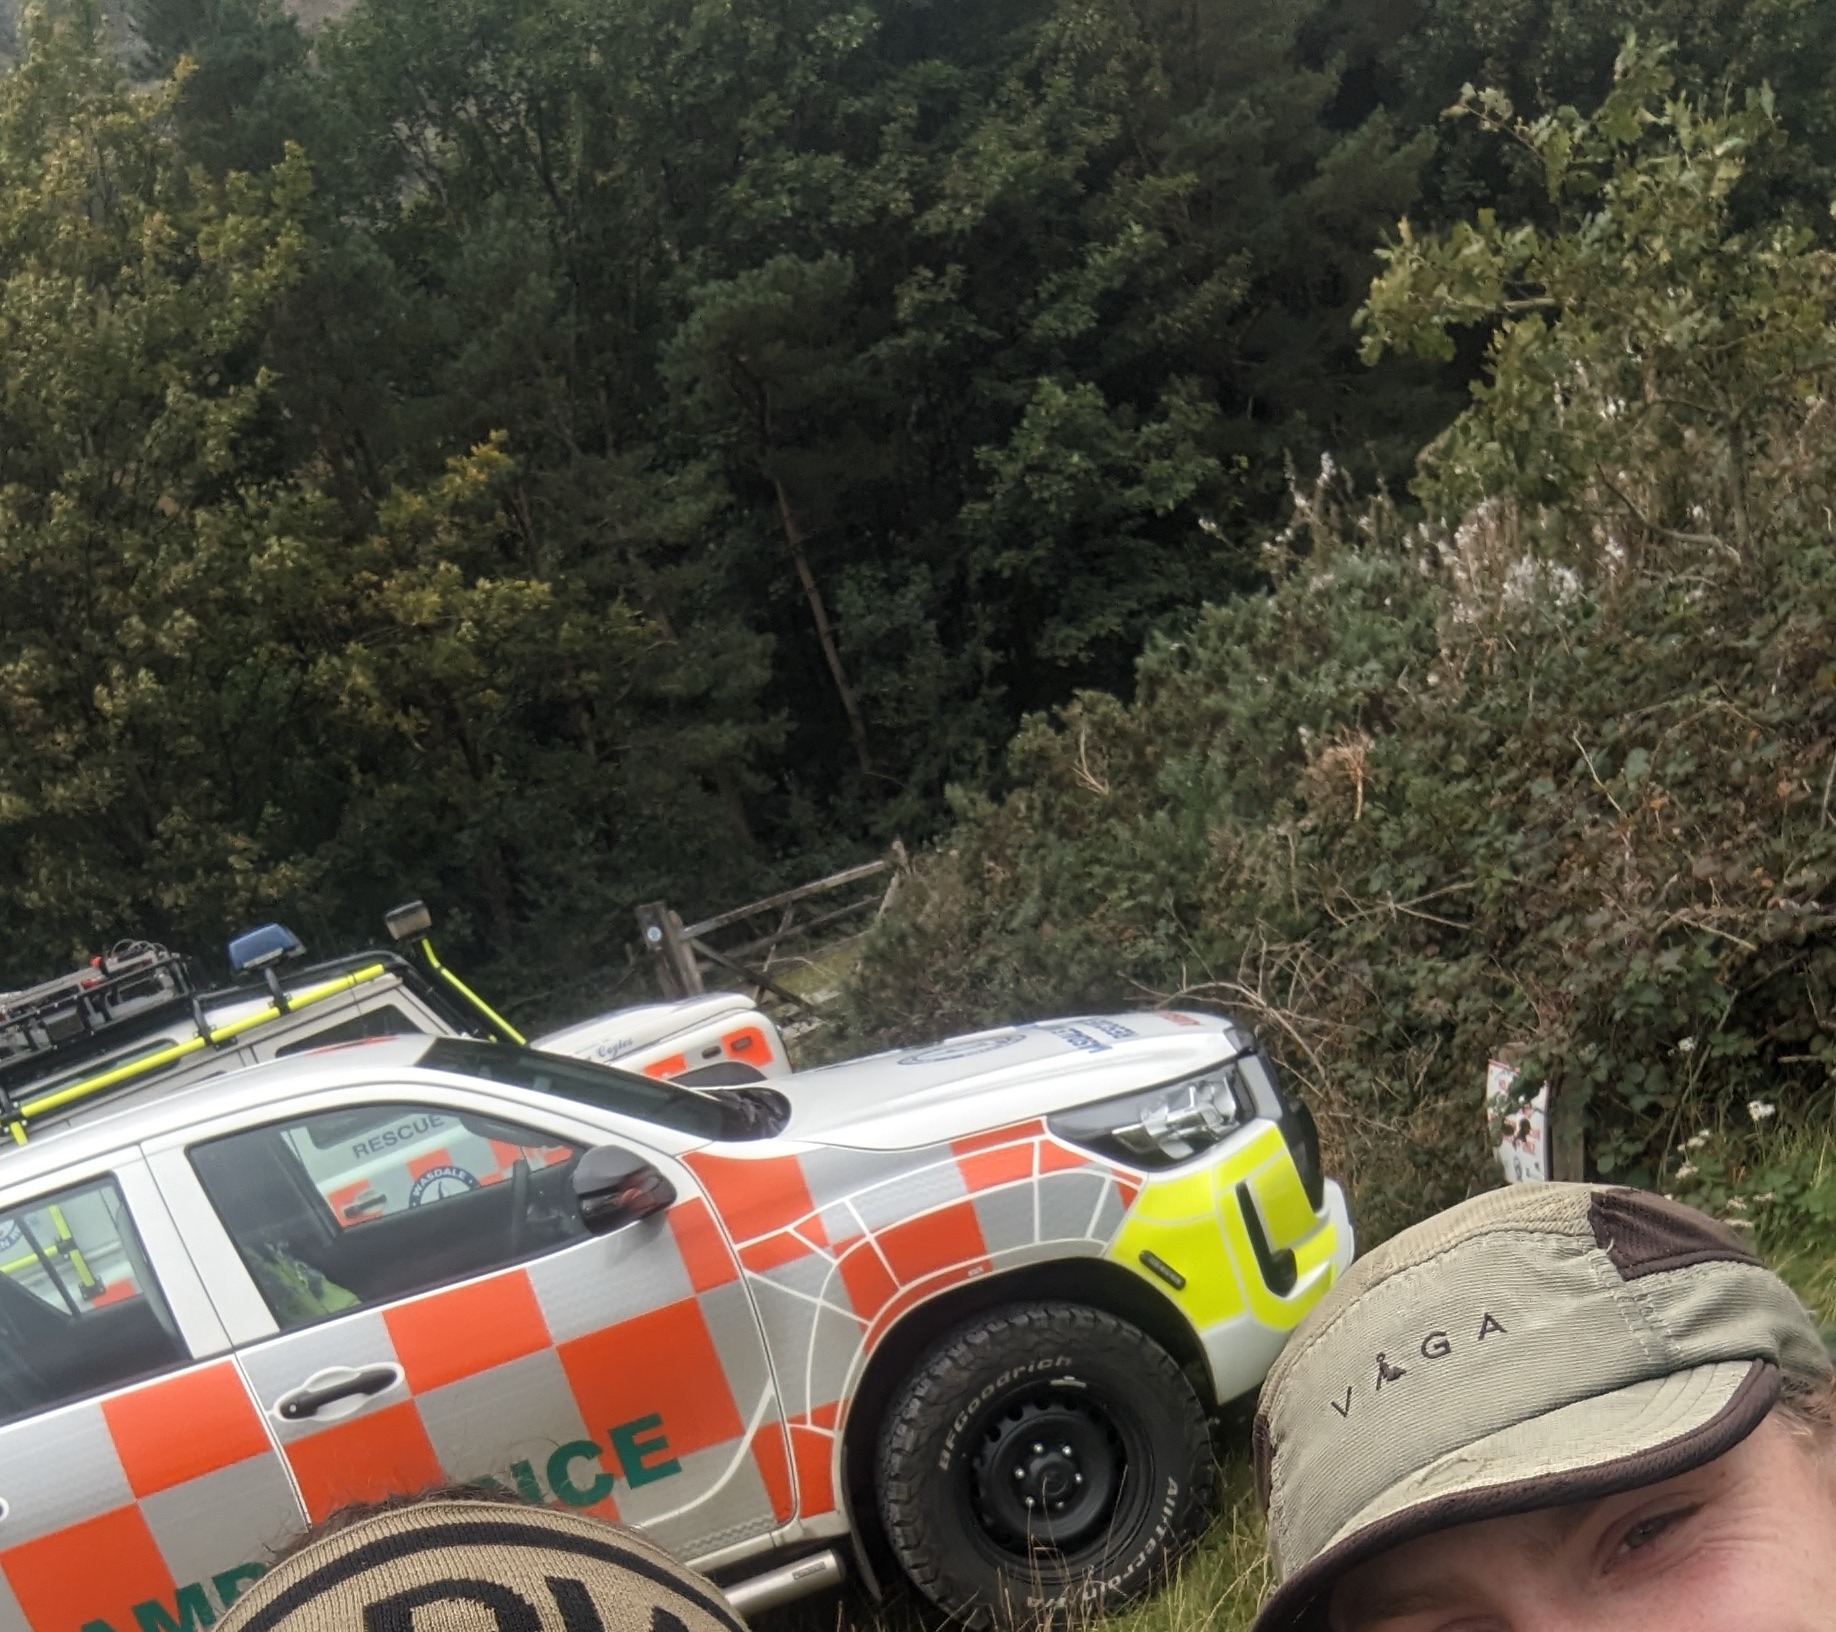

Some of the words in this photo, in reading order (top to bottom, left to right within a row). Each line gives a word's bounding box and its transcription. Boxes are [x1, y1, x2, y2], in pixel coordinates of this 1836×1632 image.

[352, 1112, 445, 1160] RESCUE
[412, 1166, 467, 1197] WASDALE
[938, 1354, 1073, 1472] BFGoodrich
